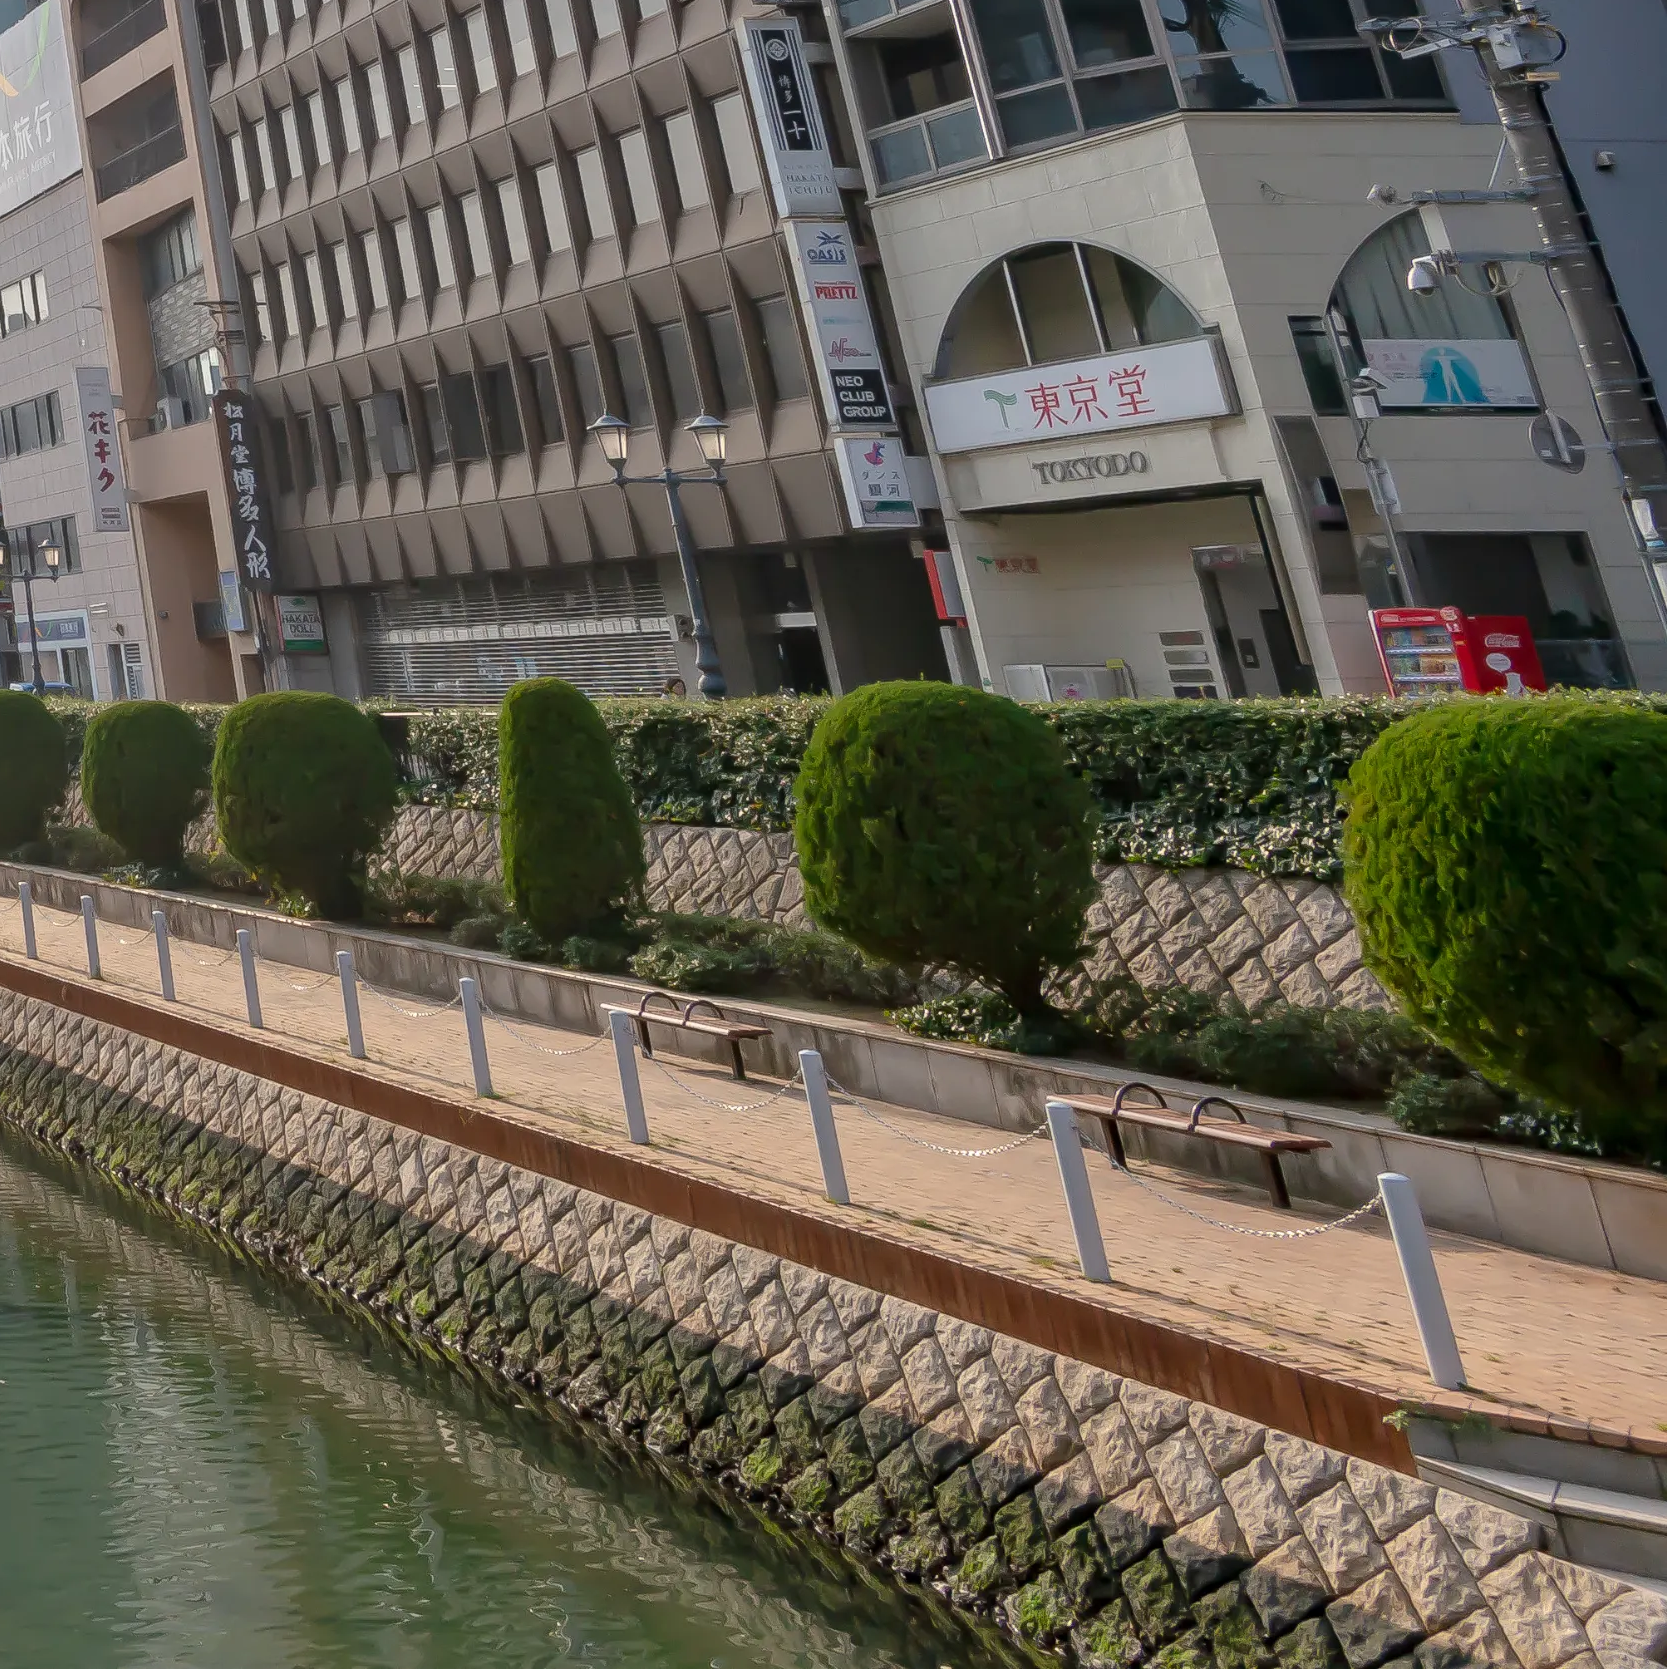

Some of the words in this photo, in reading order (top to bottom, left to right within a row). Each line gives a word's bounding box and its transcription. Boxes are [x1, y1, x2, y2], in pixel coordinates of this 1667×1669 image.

[806, 246, 847, 262] OASIS
[835, 375, 864, 388] NEO
[839, 390, 876, 403] CLUB
[1023, 363, 1156, 429] 東京堂
[843, 405, 887, 418] GROUP
[87, 410, 116, 493] 花キク
[1031, 450, 1148, 485] TOKYODO
[282, 612, 322, 624] HAKATA
[289, 623, 317, 634] DOLL
